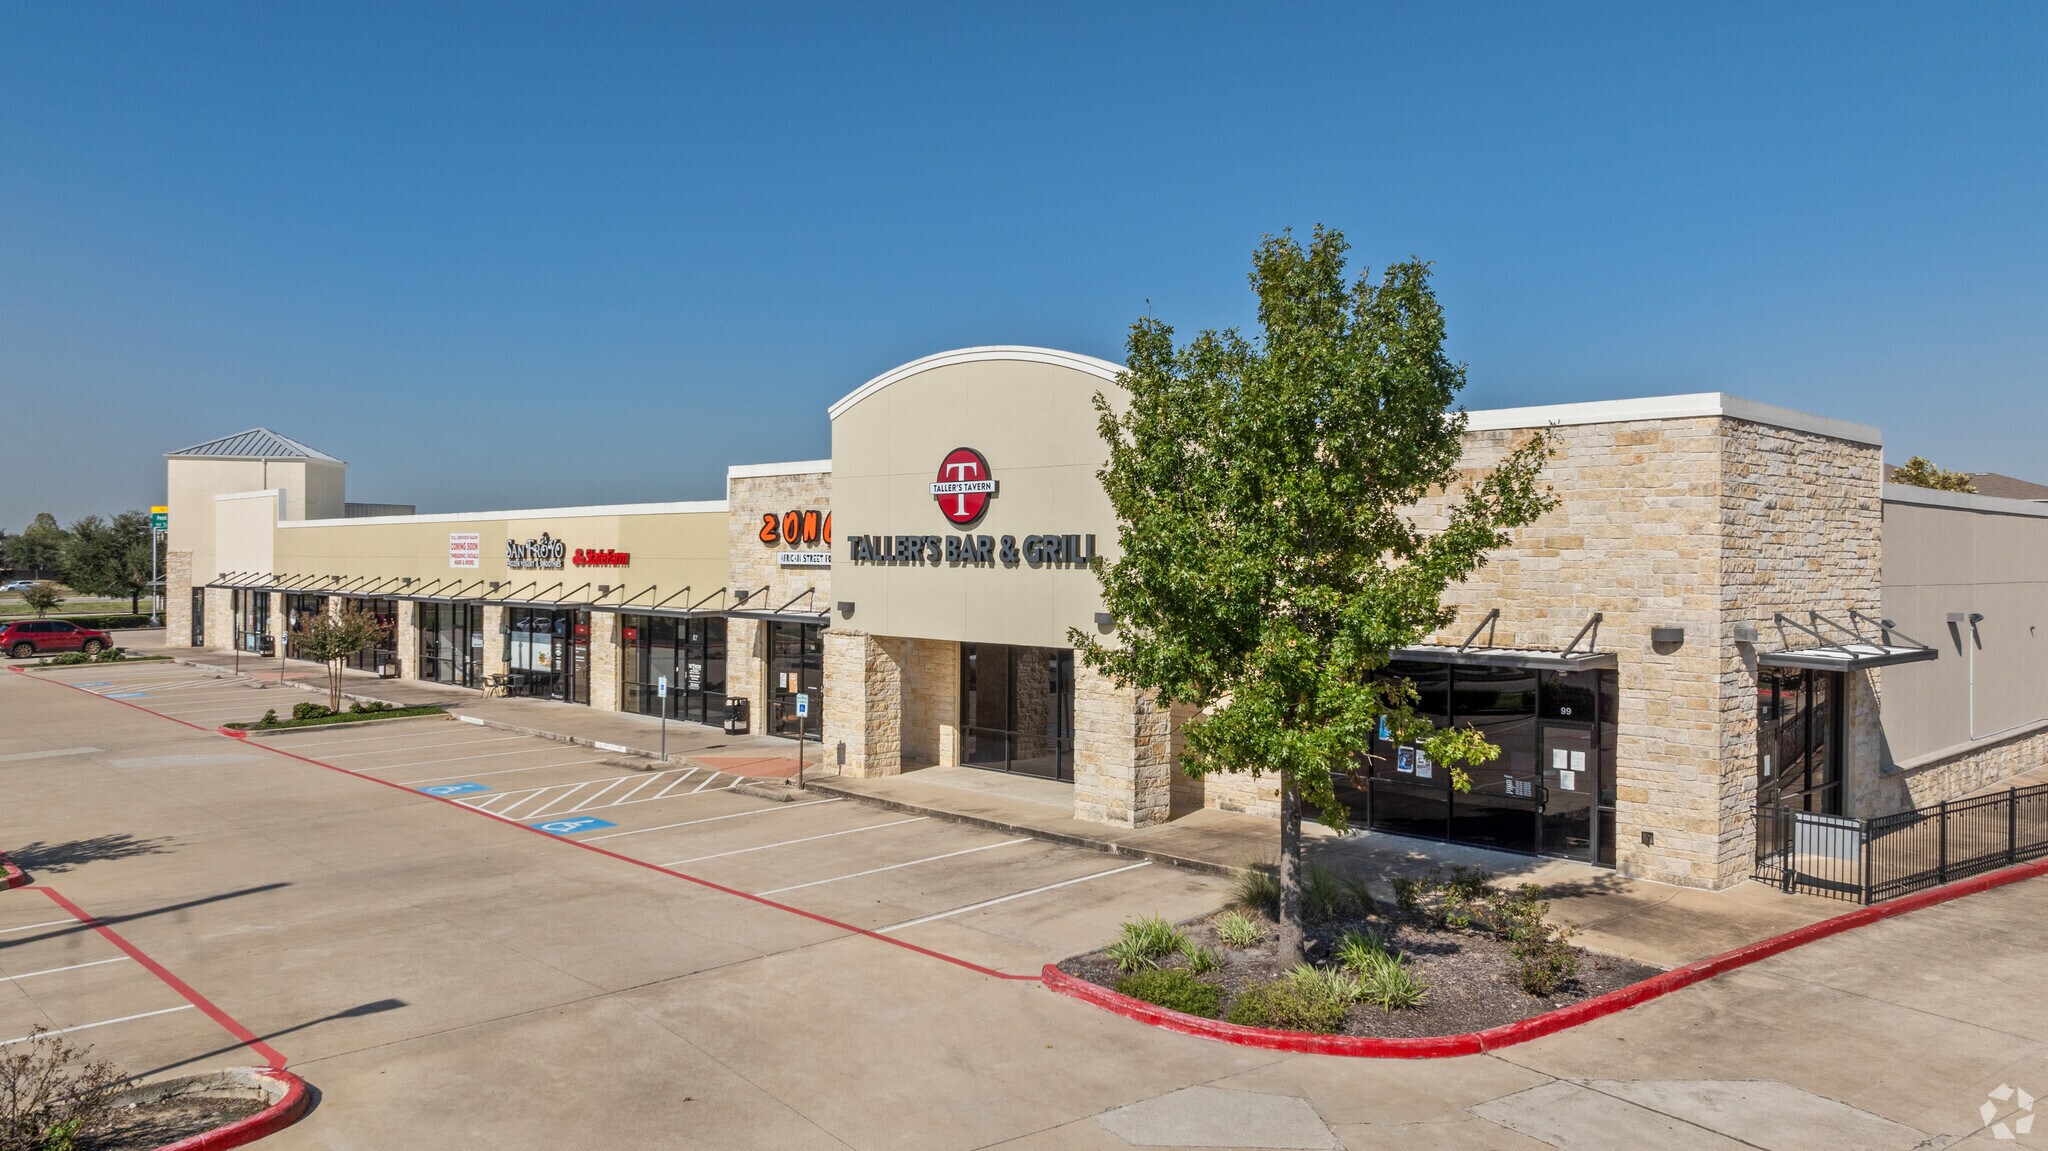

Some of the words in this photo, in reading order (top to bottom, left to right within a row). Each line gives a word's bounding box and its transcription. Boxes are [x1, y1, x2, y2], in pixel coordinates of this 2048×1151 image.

[933, 483, 963, 493] TALLER'S
[964, 482, 992, 491] TAVERN
[945, 462, 978, 516] T
[450, 542, 466, 551] COMING
[466, 542, 479, 551] SOON
[506, 538, 525, 560] SAN
[848, 535, 943, 562] TALLER'S
[945, 534, 996, 563] BAR
[999, 535, 1020, 563] &
[802, 554, 824, 563] STREET
[1560, 707, 1572, 715] 99
